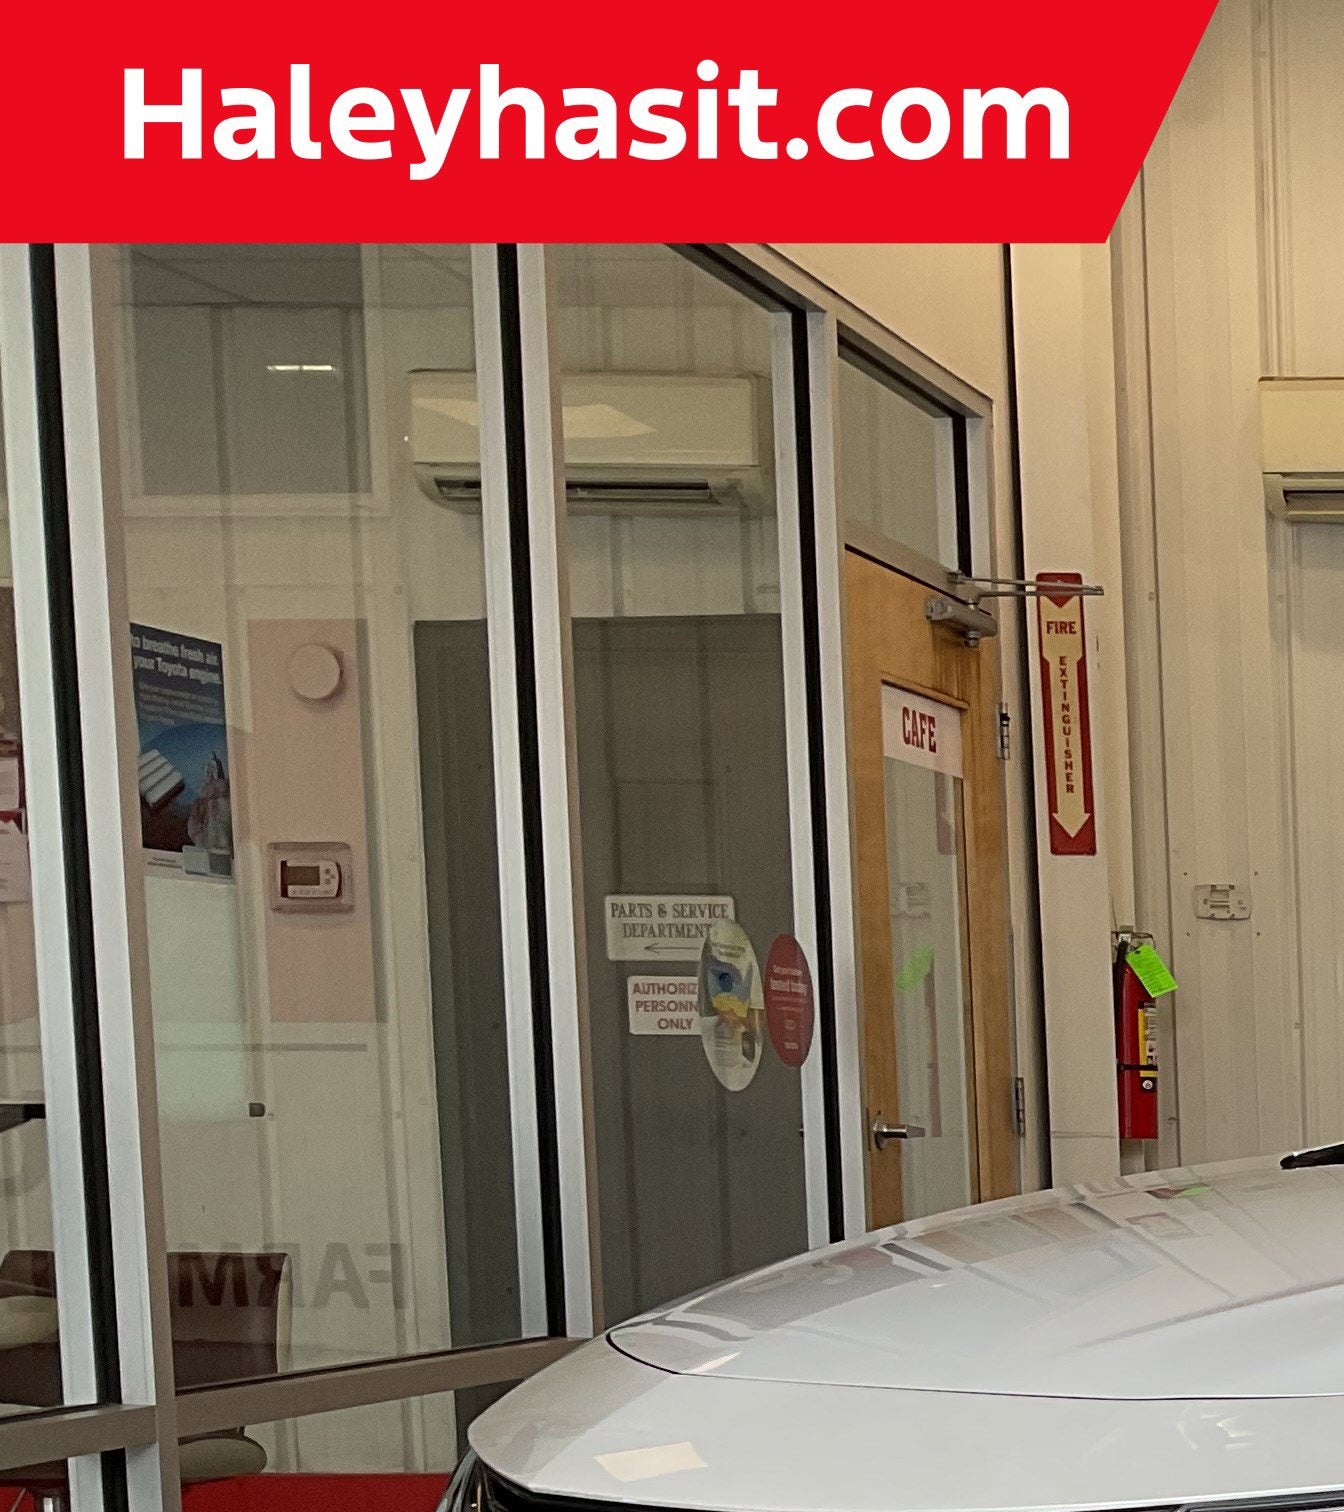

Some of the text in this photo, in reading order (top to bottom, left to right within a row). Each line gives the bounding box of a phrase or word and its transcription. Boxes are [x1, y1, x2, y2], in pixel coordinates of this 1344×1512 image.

[1046, 621, 1077, 635] FIRE
[181, 645, 205, 663] fresh
[156, 657, 188, 677] Toyota
[902, 706, 937, 753] CAFE
[1058, 655, 1075, 794] EXTINGUISHER
[611, 903, 729, 919] PARTS & SERVICE
[623, 923, 713, 938] DEPARTMENT
[632, 983, 698, 995] AUTHORIZ
[635, 1000, 698, 1012] PERSONN
[657, 1018, 694, 1030] ONLY
